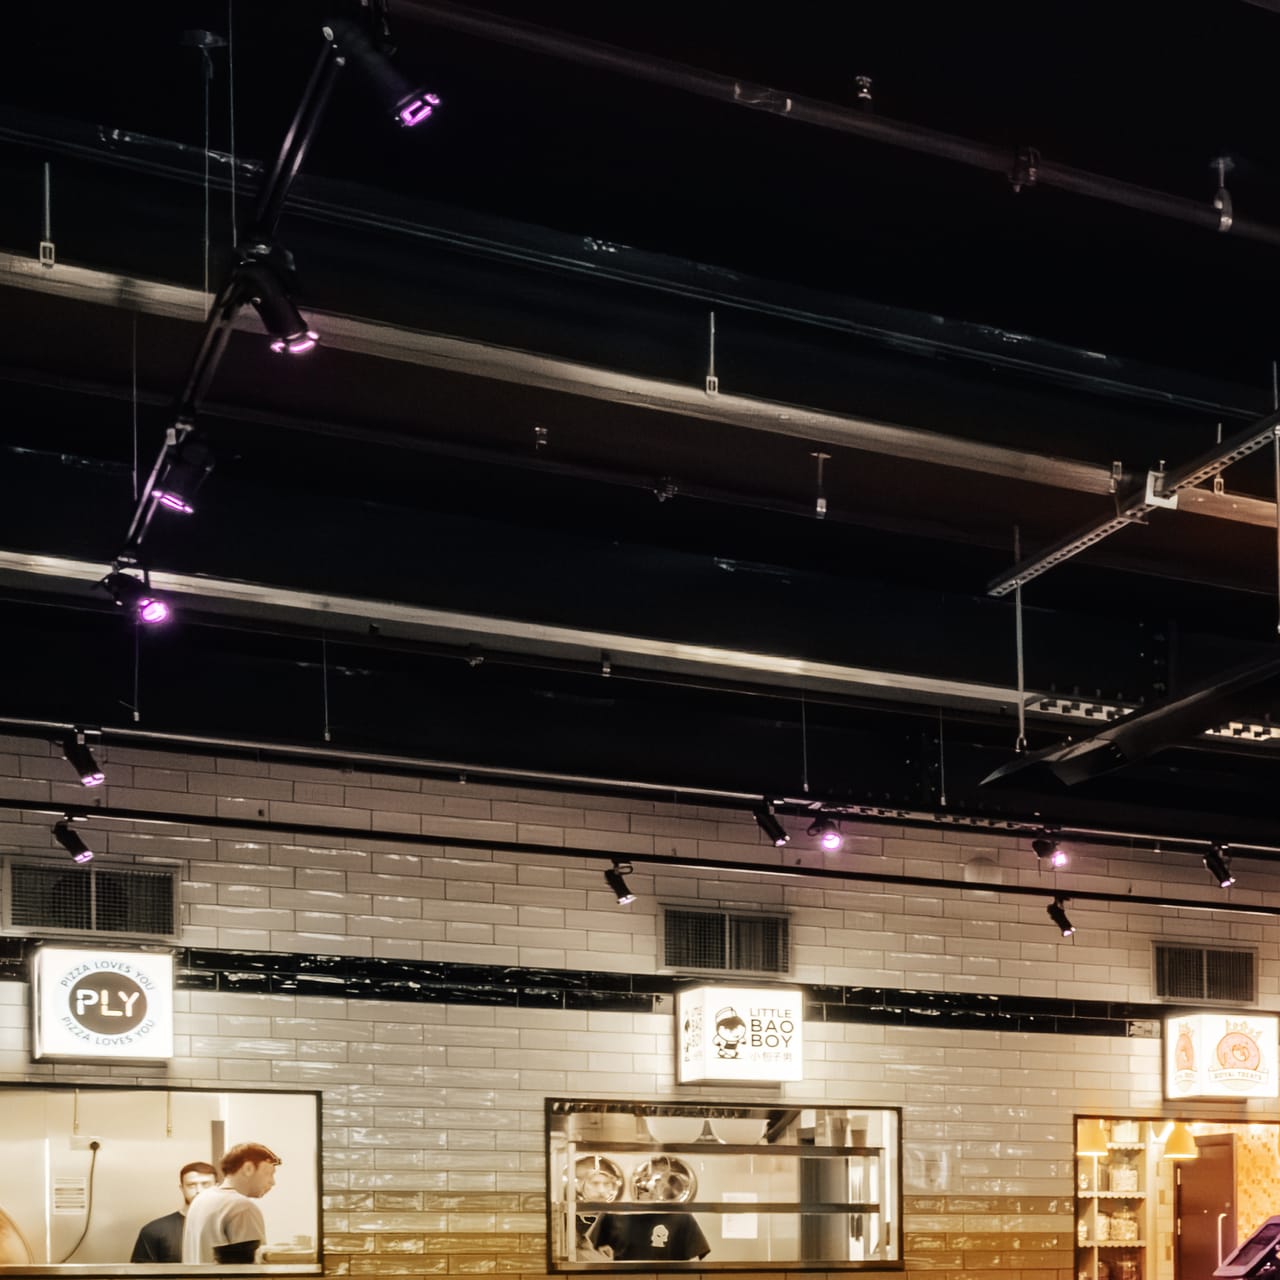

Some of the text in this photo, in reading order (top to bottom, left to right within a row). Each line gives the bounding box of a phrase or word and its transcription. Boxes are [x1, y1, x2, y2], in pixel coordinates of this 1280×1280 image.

[60, 961, 156, 991] PIZZA LOVES YOU
[76, 989, 140, 1017] PLY
[750, 1008, 792, 1018] LITTLE
[61, 1016, 156, 1046] PIZZA LOVES YOU
[751, 1019, 794, 1033] BAO
[751, 1034, 792, 1048] BOY
